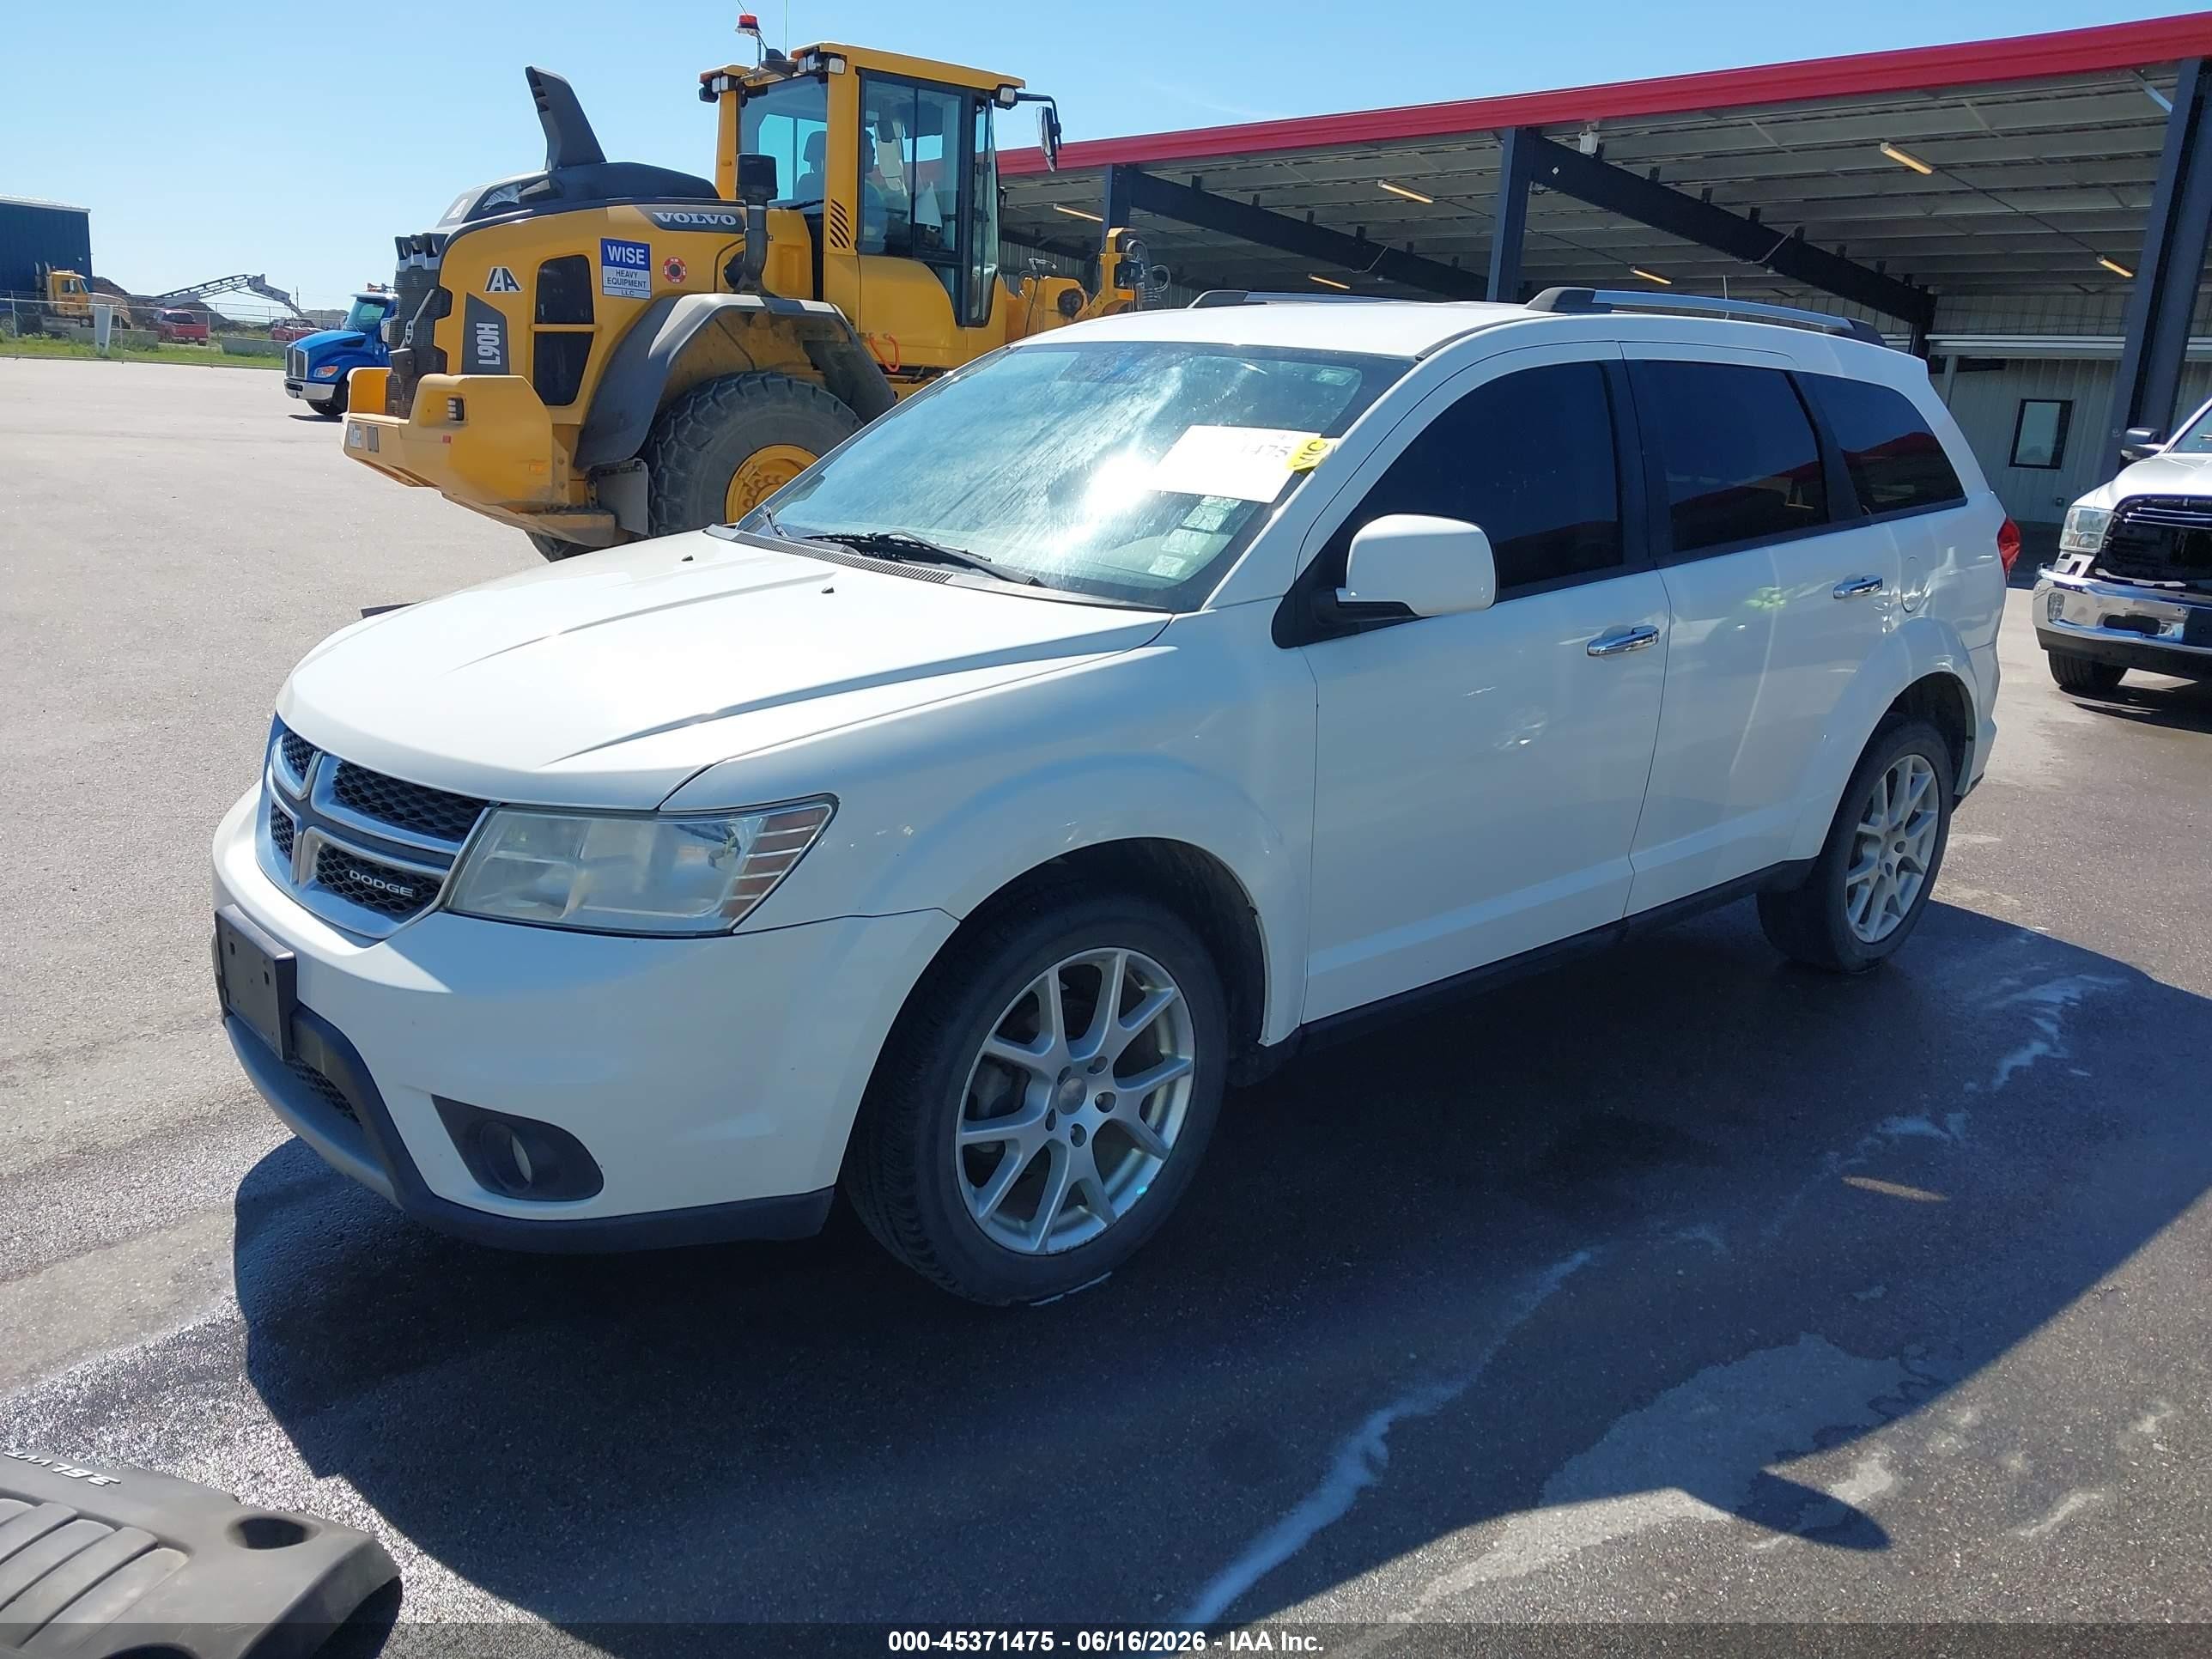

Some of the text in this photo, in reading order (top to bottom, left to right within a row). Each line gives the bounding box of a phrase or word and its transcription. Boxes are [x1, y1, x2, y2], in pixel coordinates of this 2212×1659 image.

[653, 211, 737, 226] VOLVO
[607, 245, 646, 265] WISE
[606, 276, 647, 289] EQUIPMENT
[616, 269, 638, 279] HEAVY
[476, 322, 501, 365] L90H
[1292, 441, 1328, 468] VIC
[349, 869, 414, 897] DODGE
[3, 1451, 121, 1486] 3.6L VVT
